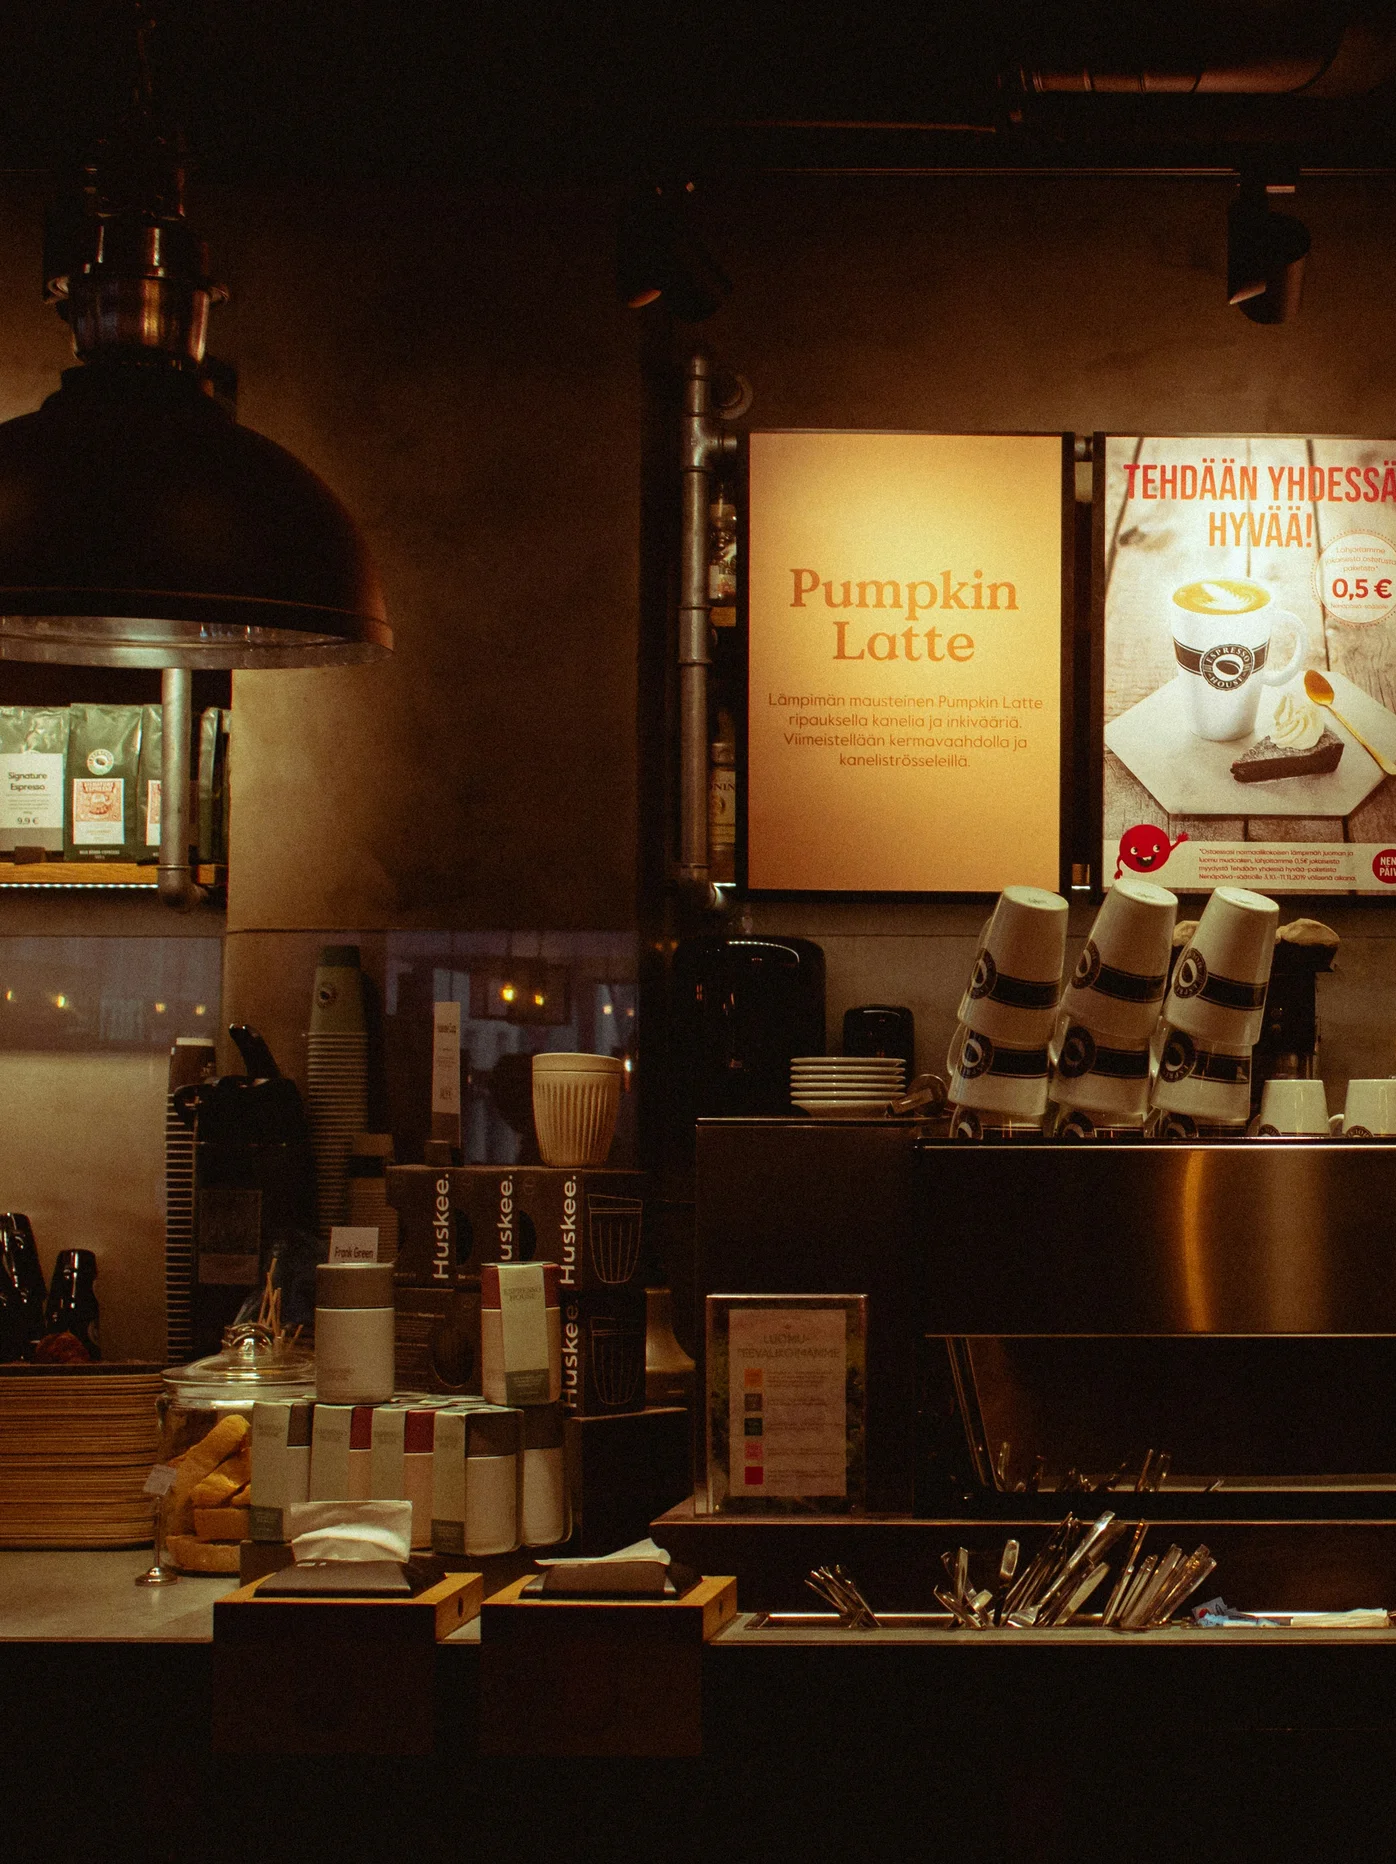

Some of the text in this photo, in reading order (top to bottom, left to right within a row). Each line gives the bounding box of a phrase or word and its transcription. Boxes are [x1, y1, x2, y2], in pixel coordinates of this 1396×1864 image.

[1123, 458, 1258, 501] TEHDÄÄN
[1208, 505, 1313, 548] HYVÄÄ!
[789, 568, 1020, 621] Pumpkin
[1332, 578, 1392, 601] 0,5 €
[833, 621, 975, 662] Latte
[1205, 646, 1250, 663] ESPRESSO
[1209, 676, 1244, 688] HOUSE
[769, 693, 1043, 710] Lämpimän mausteinen Pumpkin Latte
[789, 713, 1022, 731] ripauksella kanelia ja inkivääriä.
[784, 733, 1027, 752] Viimeistellään kermavaahdolla ja
[840, 753, 970, 767] kaneliströsseleillä.
[8, 772, 48, 782] Signature
[11, 783, 46, 792] Espresso
[432, 1173, 449, 1279] Huskee.
[497, 1174, 513, 1260] uskee.
[560, 1175, 576, 1284] Huskee.
[334, 1247, 374, 1259] Frank Green
